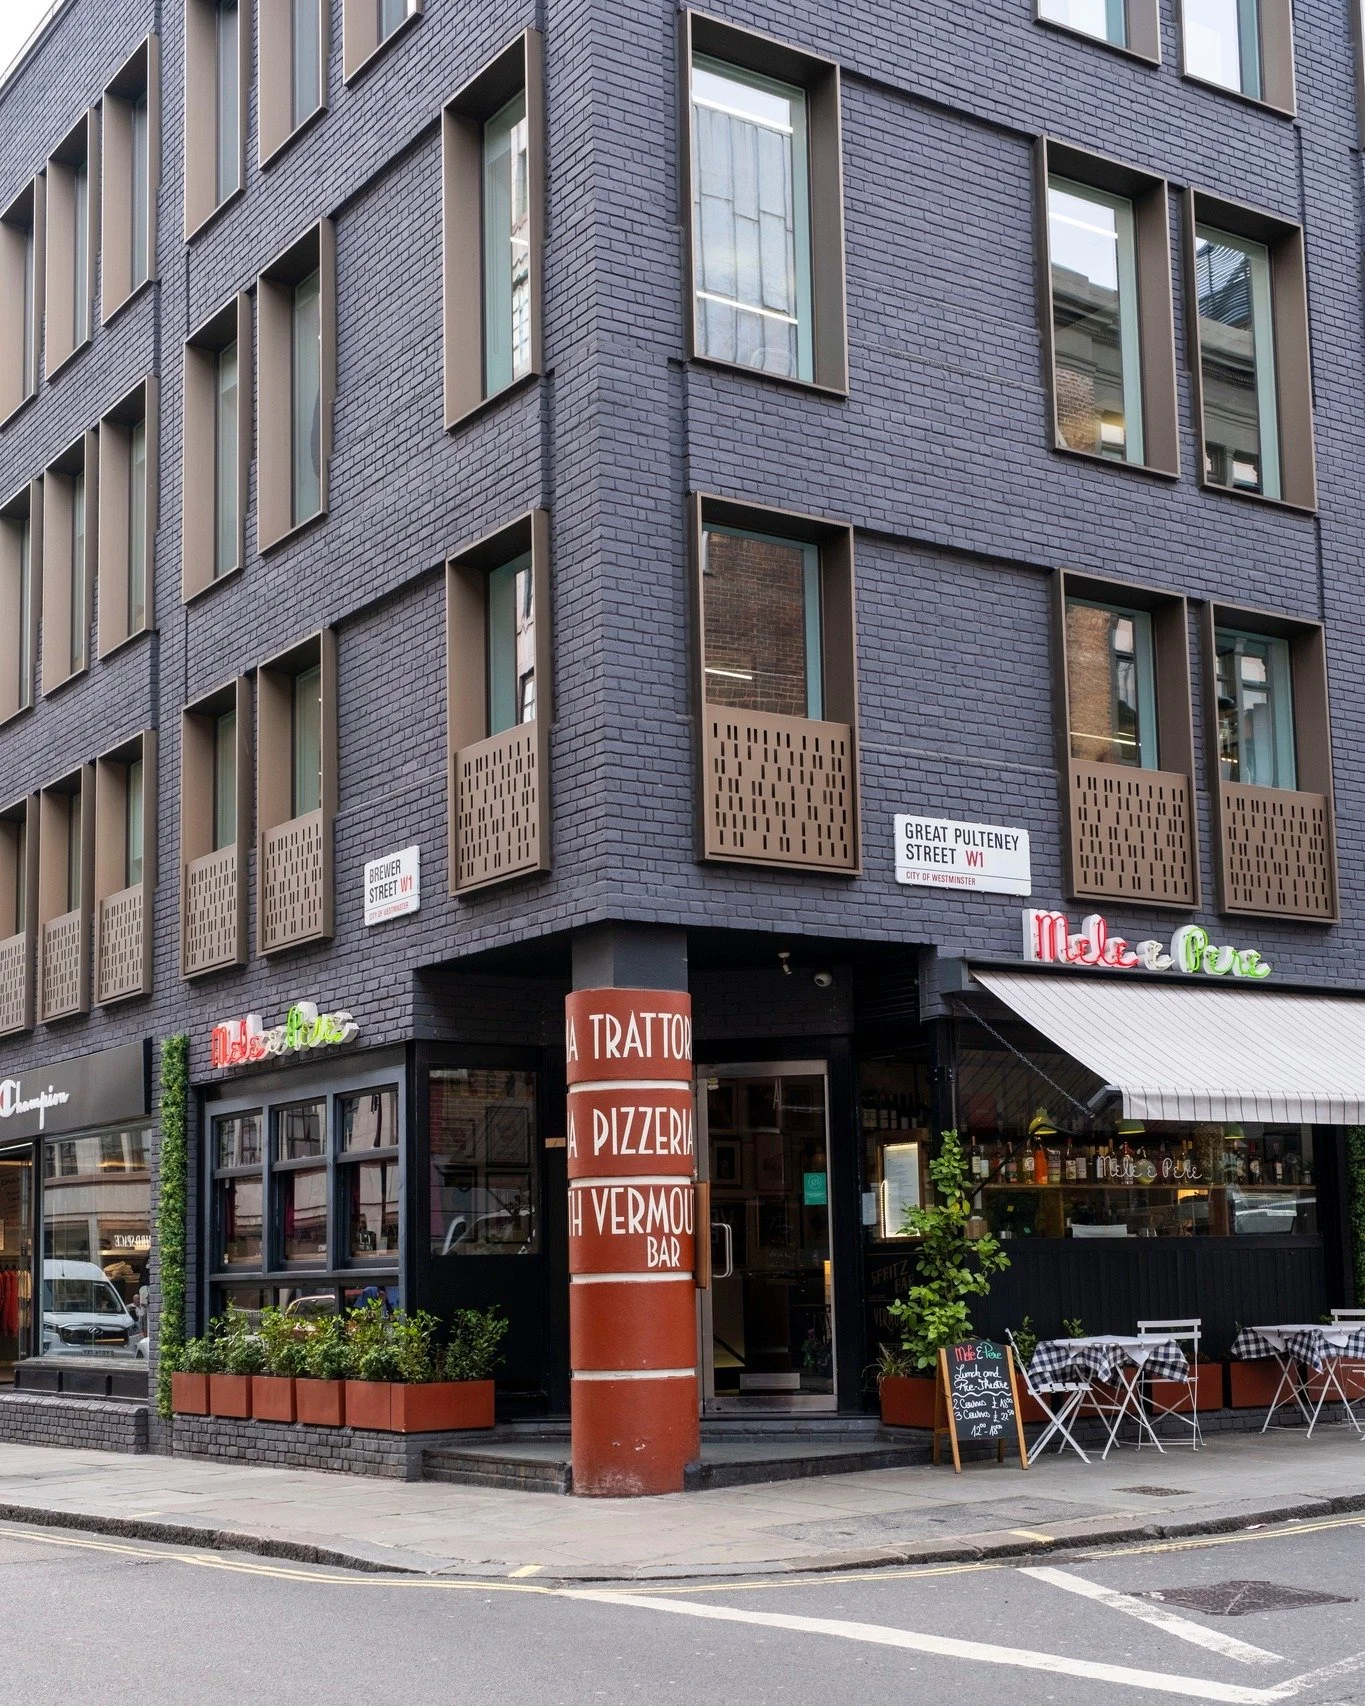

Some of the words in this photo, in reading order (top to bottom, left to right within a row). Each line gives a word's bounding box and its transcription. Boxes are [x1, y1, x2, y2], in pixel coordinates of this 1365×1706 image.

[905, 822, 948, 843] GREAT
[954, 828, 1020, 851] PULTENEY
[906, 843, 956, 865] STREET
[965, 850, 984, 868] W1
[369, 858, 401, 884] BREWER
[906, 871, 920, 880] CITY
[922, 872, 930, 881] OF
[932, 874, 976, 886] WESTMINSTER
[369, 879, 398, 904] STREET
[400, 875, 413, 893] W1
[369, 912, 377, 921] CITY
[384, 901, 409, 916] WESTMINSTER
[1023, 909, 1139, 969] Mele
[1171, 924, 1272, 978] Pere
[0, 1079, 70, 1130] Champion
[593, 1106, 693, 1156] PIZZERIA
[1098, 1155, 1142, 1178] Mele
[1162, 1157, 1203, 1179] Pere
[647, 1236, 681, 1268] BAR
[871, 1259, 909, 1287] SPRITZ
[954, 1344, 977, 1362] Mele
[981, 1341, 1003, 1360] Pere
[954, 1363, 982, 1380] Lunch
[982, 1366, 1002, 1379] and
[953, 1398, 960, 1410] 2
[954, 1411, 963, 1421] 3
